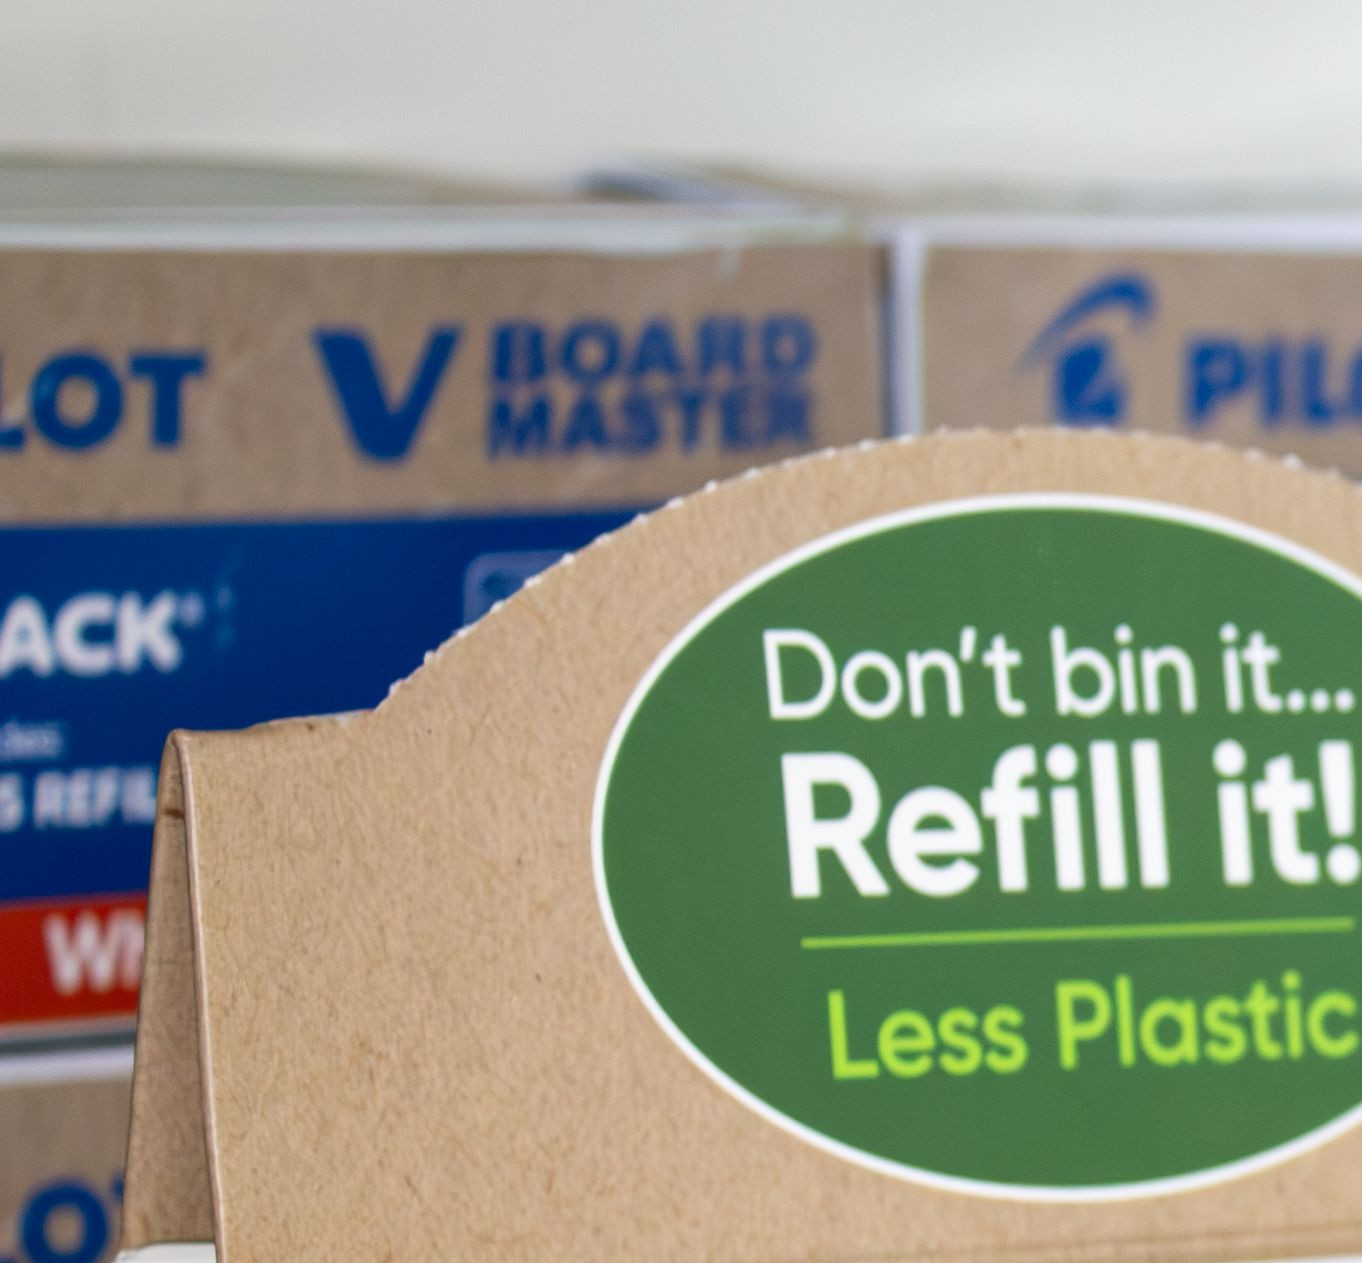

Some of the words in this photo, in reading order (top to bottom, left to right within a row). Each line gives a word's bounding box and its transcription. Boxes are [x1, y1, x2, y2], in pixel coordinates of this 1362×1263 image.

[311, 325, 464, 464] V
[489, 314, 818, 387] BOARD
[490, 384, 816, 460] MASTER
[763, 627, 1026, 720] Don't
[1050, 624, 1196, 717] bin
[1219, 622, 1356, 715] it...
[781, 739, 1170, 899] Refill
[1212, 739, 1362, 888] it!
[828, 990, 1029, 1080] Less
[1055, 969, 1361, 1071] Plastic
